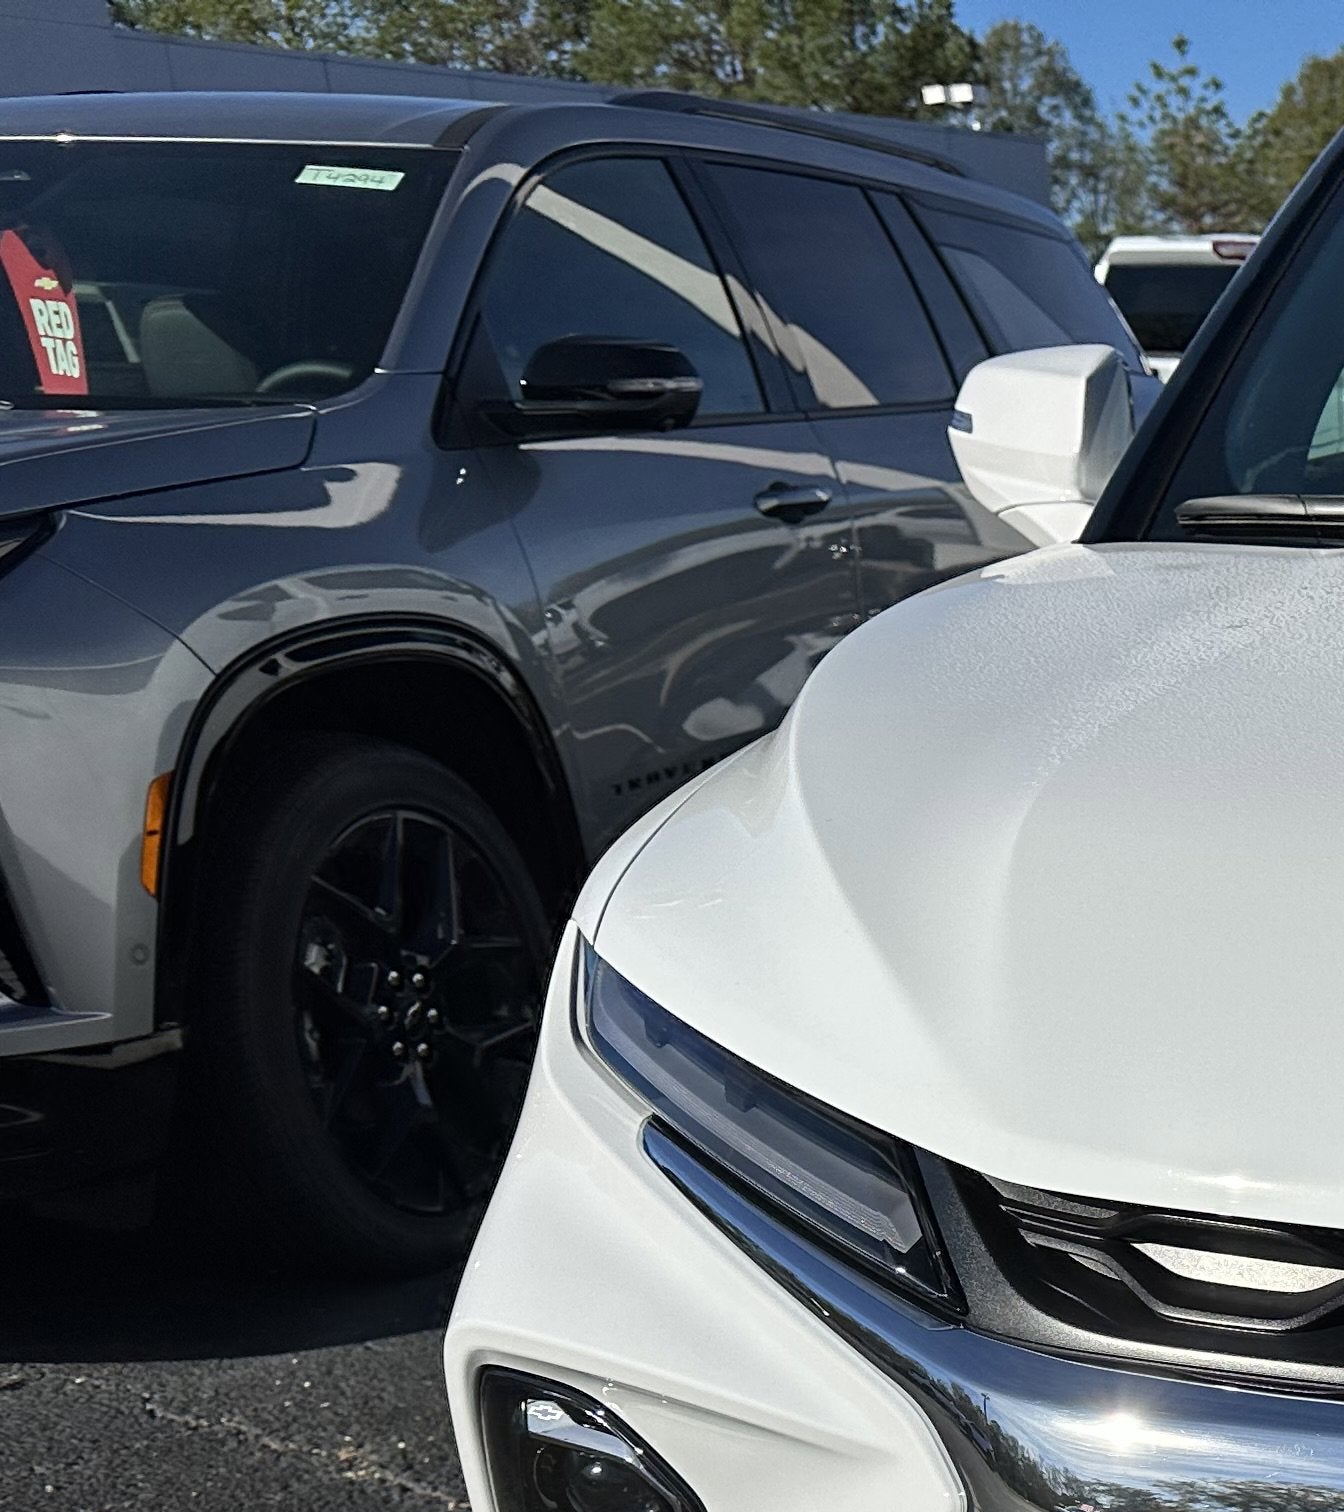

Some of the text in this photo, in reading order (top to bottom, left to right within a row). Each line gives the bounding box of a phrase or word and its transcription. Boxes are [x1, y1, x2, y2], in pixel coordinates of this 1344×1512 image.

[307, 168, 385, 185] T4294
[29, 298, 74, 339] RED
[40, 337, 80, 378] TAG
